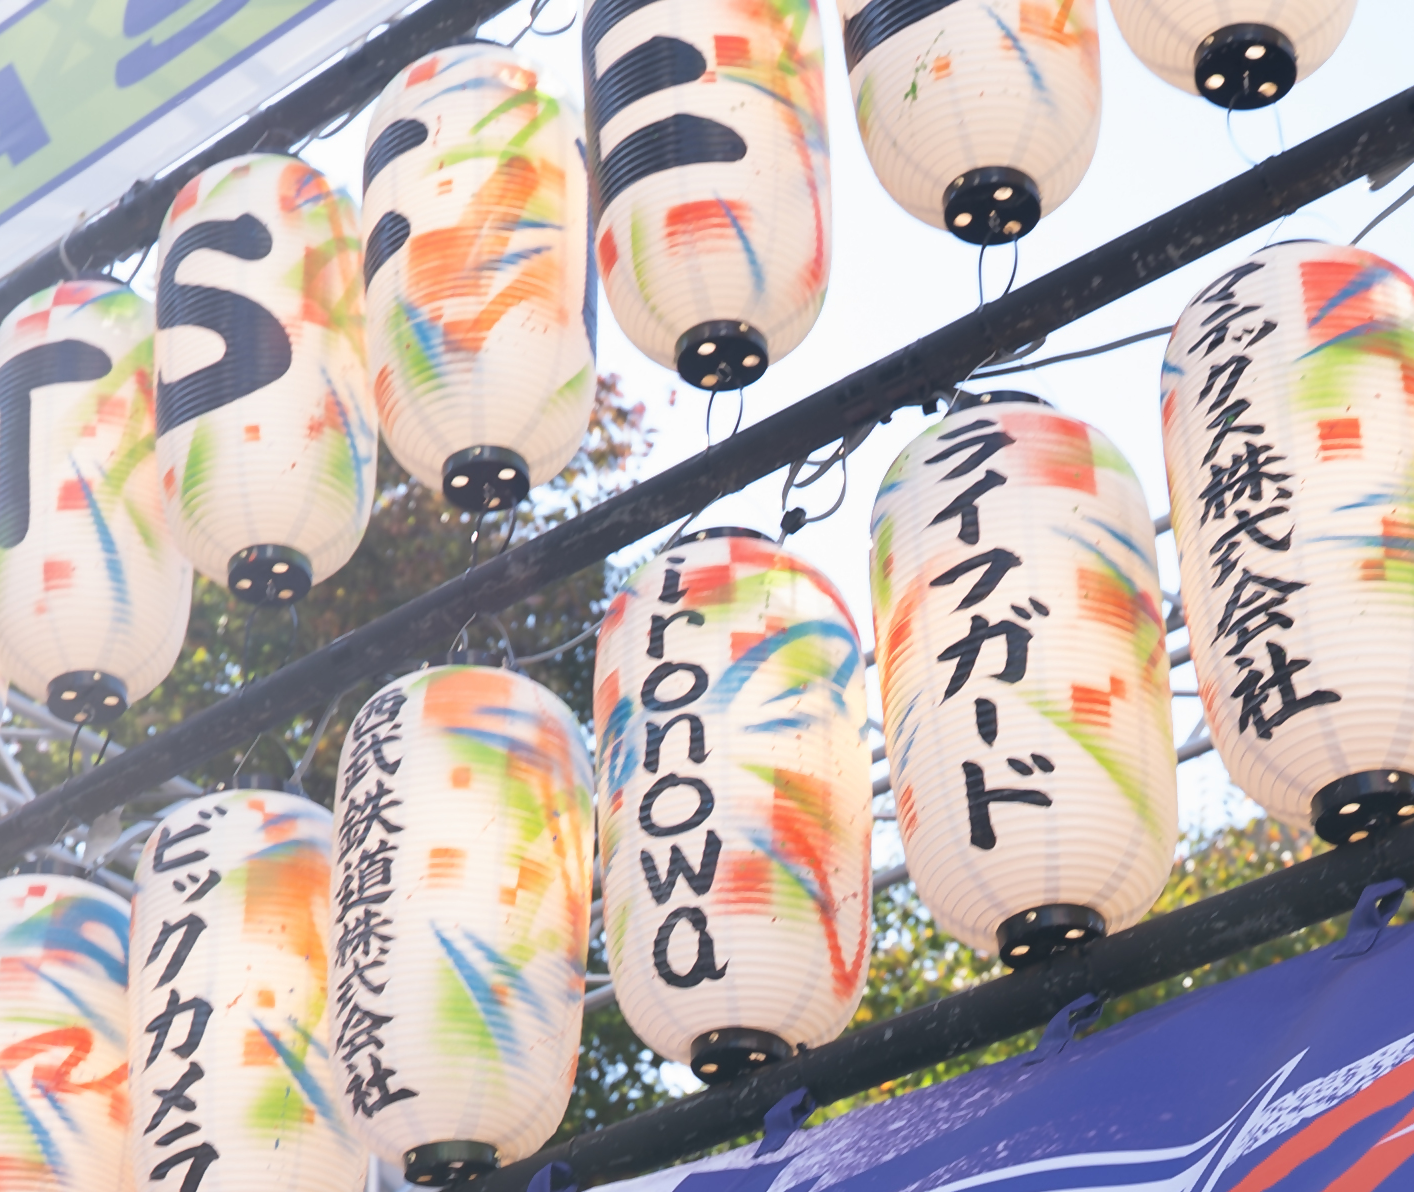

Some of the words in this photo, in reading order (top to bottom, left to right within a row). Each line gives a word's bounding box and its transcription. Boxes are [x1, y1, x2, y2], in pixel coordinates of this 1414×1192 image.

[926, 419, 1054, 850] ライフガード
[1186, 261, 1342, 740] マテックス株式会社
[334, 686, 420, 1119] 西武鉄道株式会社
[639, 555, 728, 989] ironowa
